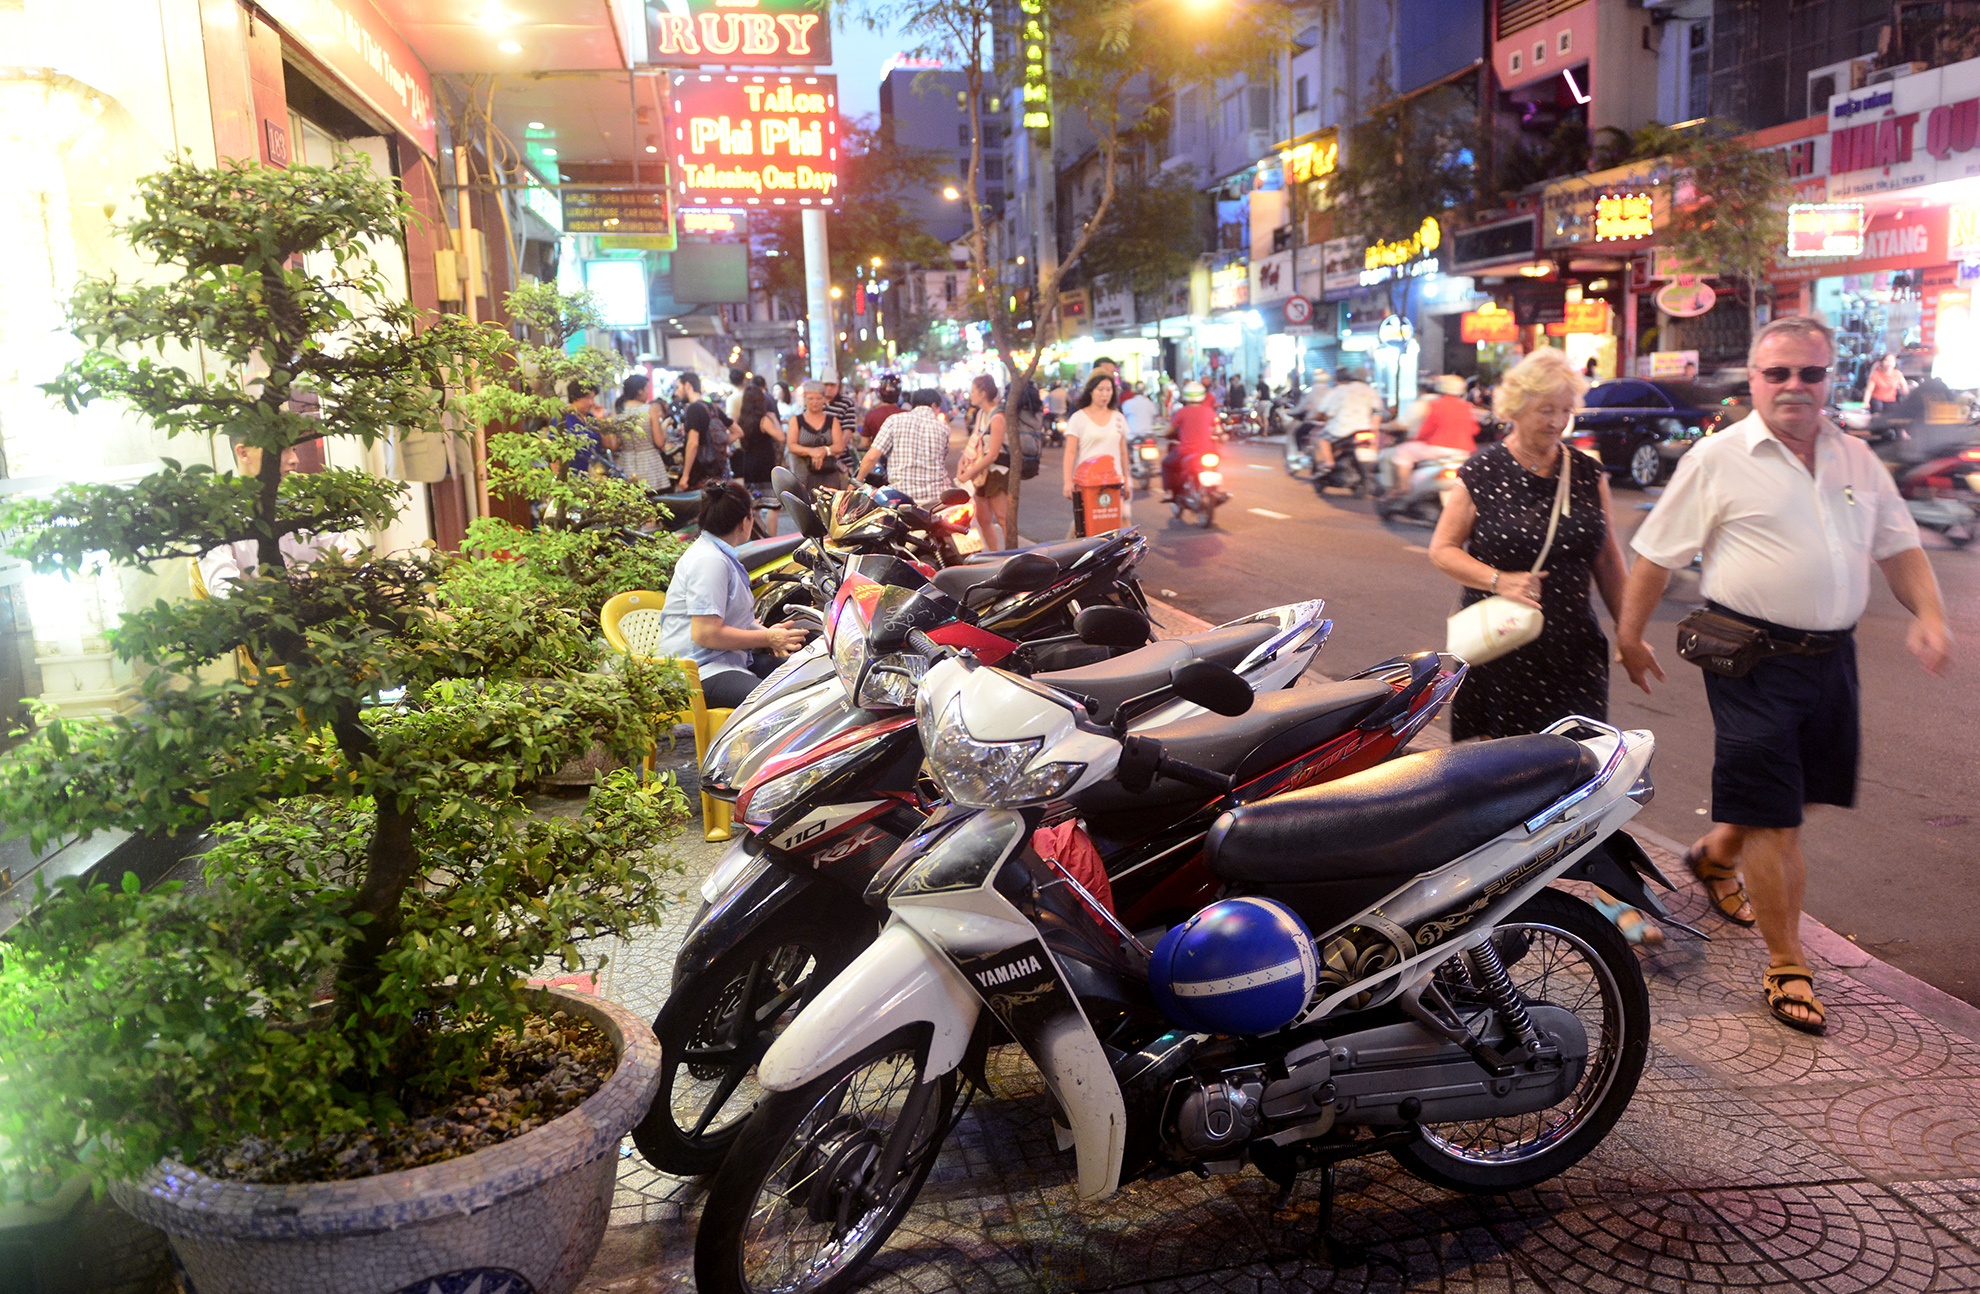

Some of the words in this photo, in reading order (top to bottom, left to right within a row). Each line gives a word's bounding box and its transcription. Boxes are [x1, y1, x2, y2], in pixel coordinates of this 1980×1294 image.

[657, 13, 819, 55] RUBY
[744, 85, 826, 113] Tailor
[268, 127, 287, 160] 183
[690, 116, 753, 155] Phi
[760, 117, 823, 156] Phi
[1830, 108, 1920, 176] NHẬT
[1926, 97, 1980, 161] QU
[683, 163, 762, 194] Tailoring
[783, 820, 827, 849] 110
[1483, 846, 1555, 895] SIRIUS
[975, 955, 1042, 988] YAMAHA
